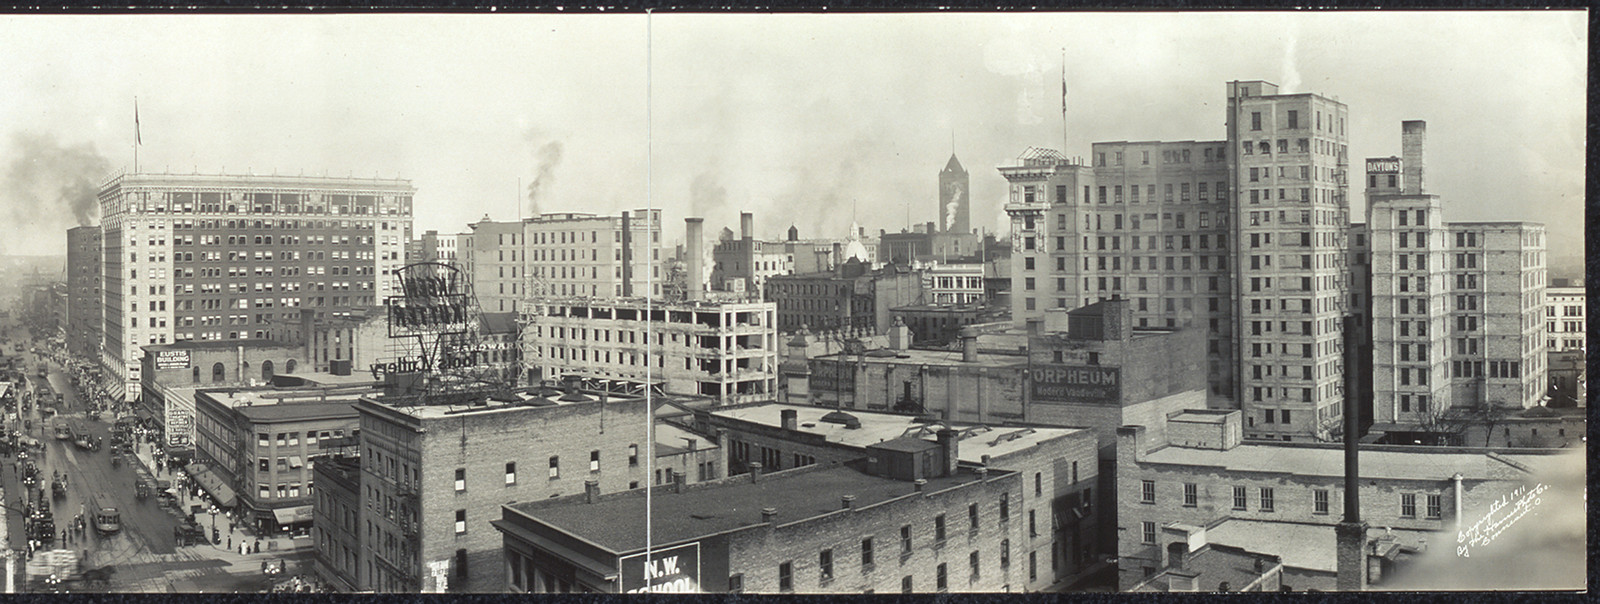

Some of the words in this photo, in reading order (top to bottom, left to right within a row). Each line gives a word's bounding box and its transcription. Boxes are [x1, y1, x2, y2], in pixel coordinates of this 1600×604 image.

[157, 355, 190, 363] BUILDING
[1033, 369, 1116, 386] ORPHEUM
[644, 556, 681, 581] N.W.
